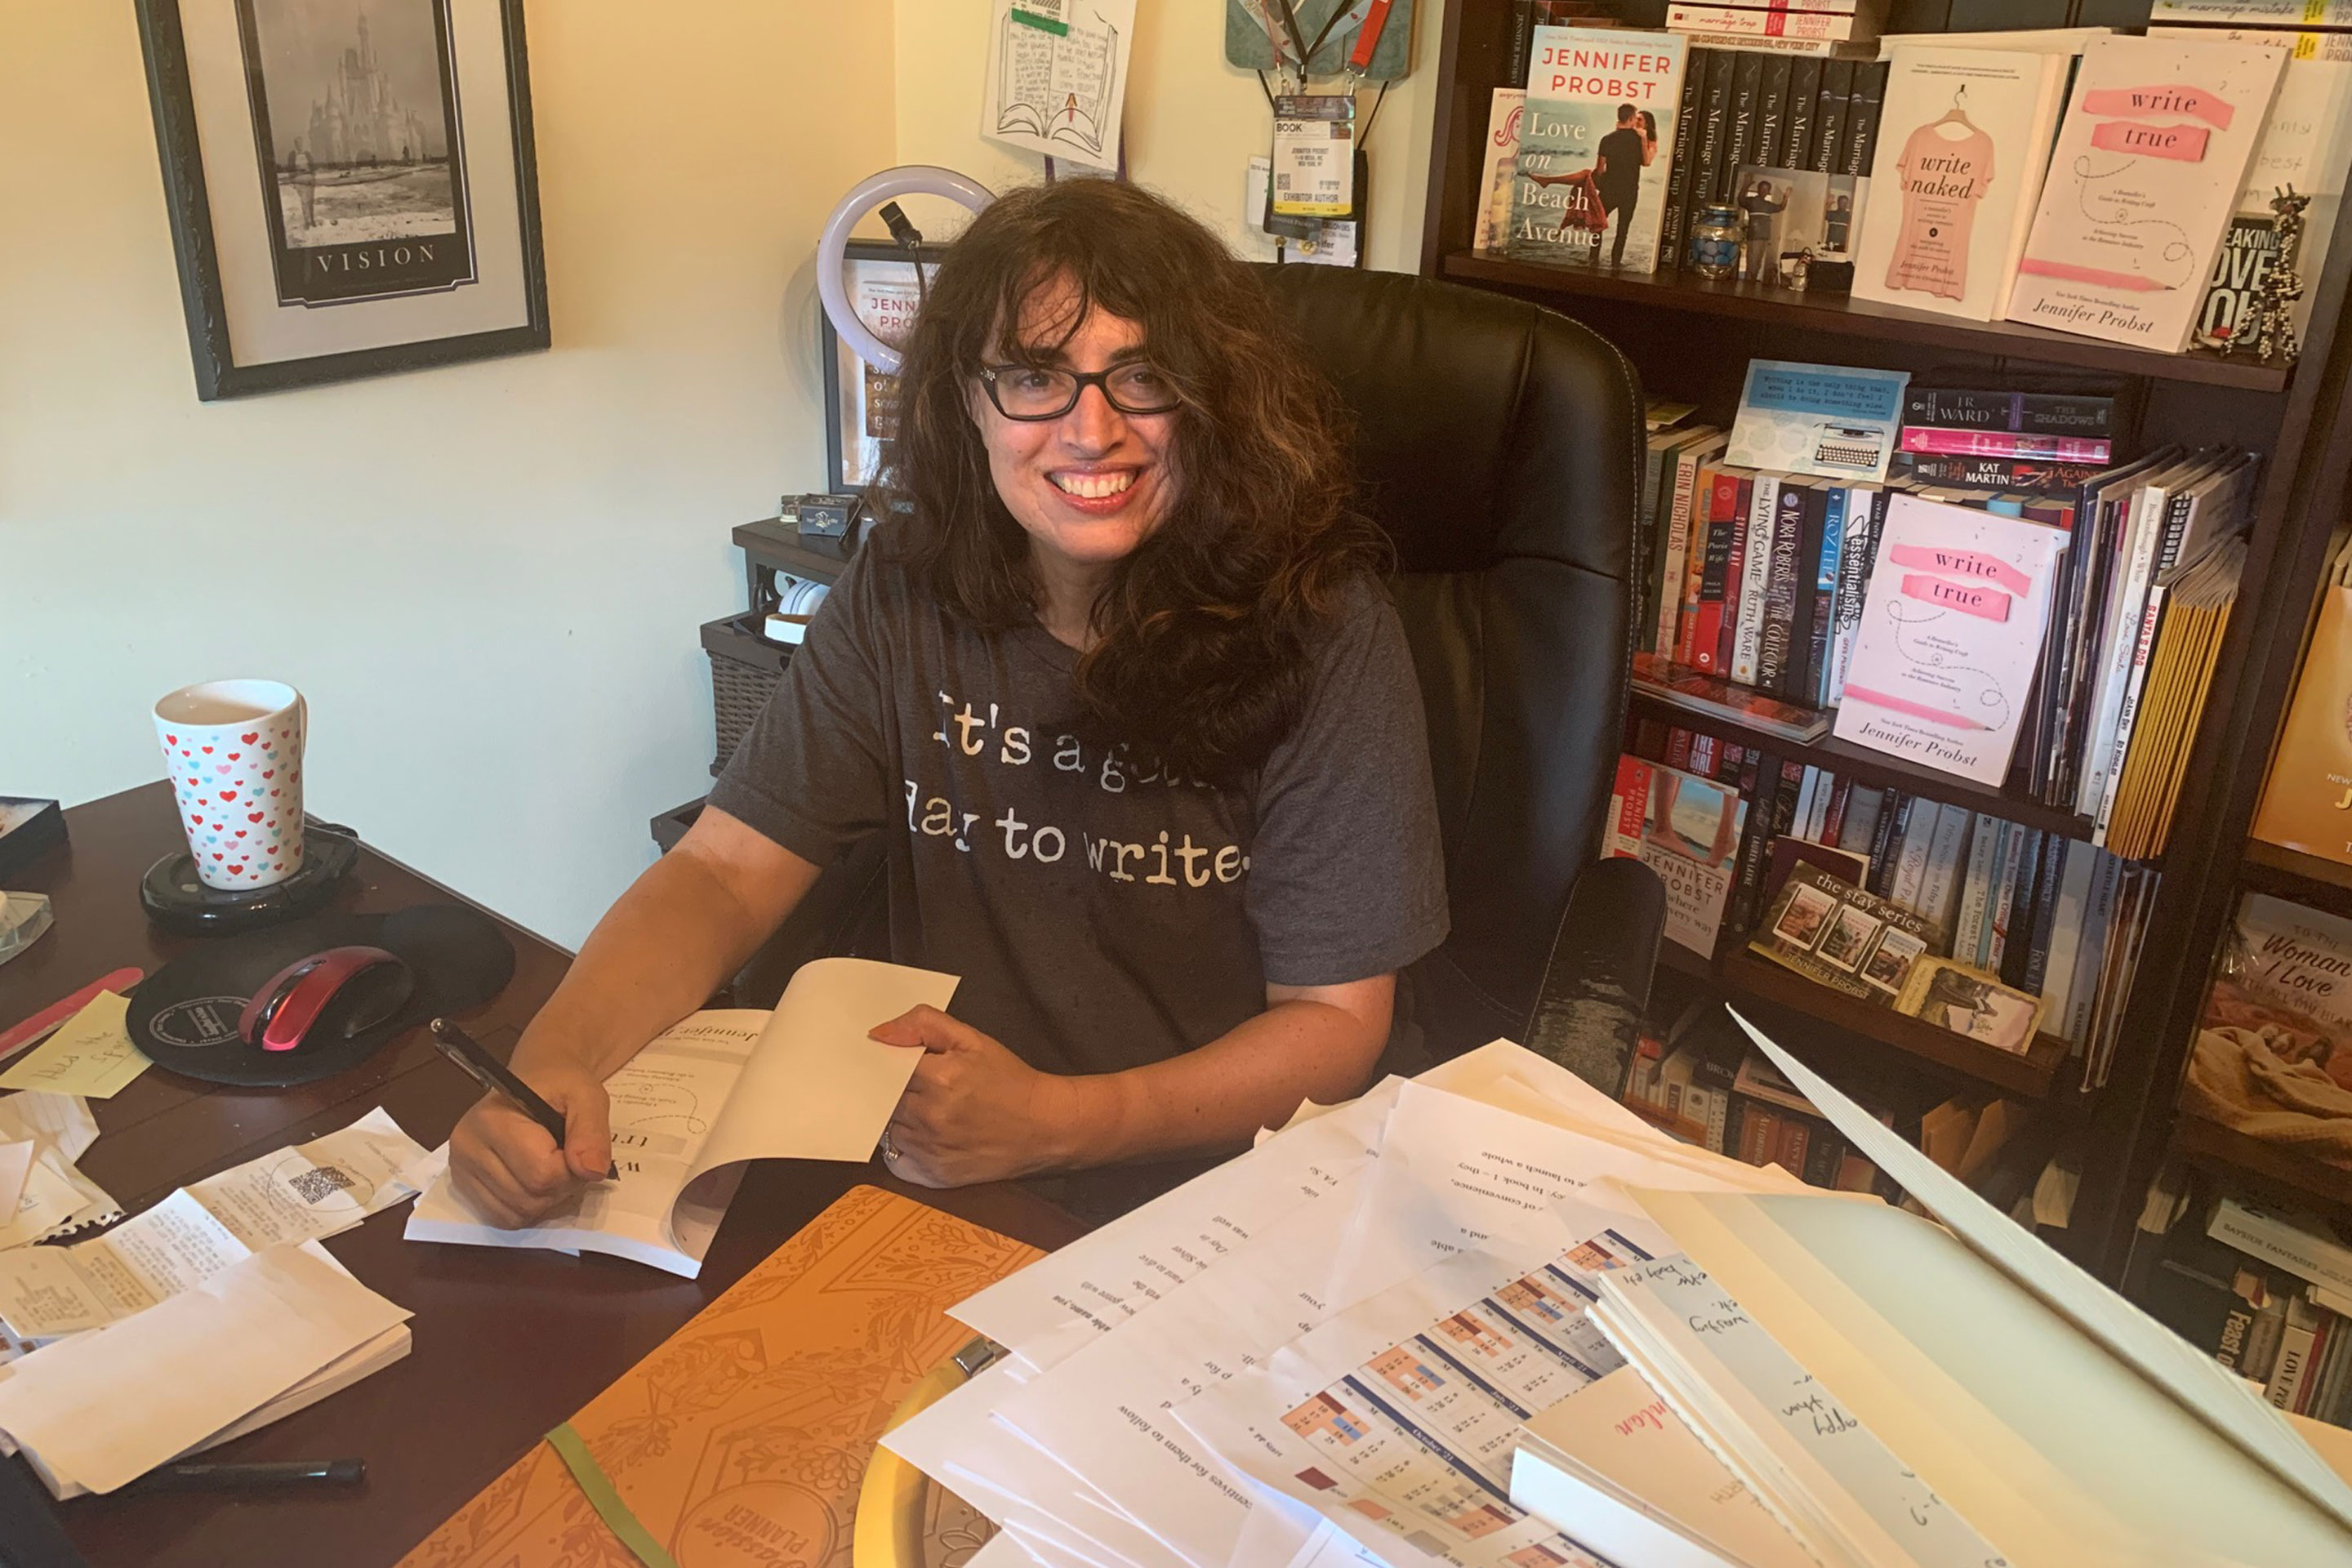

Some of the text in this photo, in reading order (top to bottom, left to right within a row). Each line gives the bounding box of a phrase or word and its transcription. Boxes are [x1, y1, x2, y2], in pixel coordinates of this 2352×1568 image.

[1795, 16, 1832, 29] JENNIFER
[1797, 27, 1827, 39] PROBST
[1542, 47, 1671, 74] JENNIFER
[1552, 75, 1656, 100] PROBST
[1685, 85, 1693, 103] The
[1740, 90, 1749, 108] The
[1766, 92, 1777, 110] The
[1797, 95, 1807, 113] The
[2131, 90, 2198, 114] write
[1276, 122, 1303, 133] BOOK
[1529, 113, 1586, 140] Love
[1826, 114, 1835, 128] The
[1857, 118, 1866, 132] The
[1675, 106, 1695, 163] Marriage
[1696, 87, 1722, 199] The Marriage Trap
[2124, 127, 2178, 149] true
[1525, 153, 1552, 170] on
[1920, 153, 1971, 176] write
[1671, 164, 1686, 197] Trap
[1910, 176, 1976, 200] naked
[1283, 192, 1339, 203] EXHIBITOR AUTHOR
[1521, 182, 1589, 212] Beach
[1517, 217, 1601, 247] Avenue
[317, 244, 434, 273] VISION
[2033, 298, 2154, 334] Jennifer Probst
[1824, 381, 1841, 390] only
[1940, 408, 1991, 423] WARD
[2034, 414, 2096, 425] SHADOWS
[1965, 471, 2010, 486] MARTIN
[1979, 462, 2001, 474] KAT
[1668, 461, 1694, 552] ERIN NICHOLAS
[1755, 497, 1771, 540] LYING
[1712, 528, 1728, 537] The
[1779, 510, 1801, 541] NORA
[1825, 514, 1841, 552] ROZ
[1873, 500, 1884, 541] ANN RYAN
[1708, 542, 1729, 550] Paris
[1730, 515, 1746, 568] SYLVIA DAY
[1708, 554, 1726, 564] Wife
[1750, 540, 1766, 581] GAME
[1773, 541, 1797, 583] ROBERTS
[1936, 553, 1998, 579] write
[1842, 537, 1868, 618] essentialism
[1933, 582, 1983, 608] true
[1744, 589, 1757, 628] RUTH
[2137, 604, 2158, 648] SANTA'S
[1740, 627, 1755, 660] WARE
[1761, 619, 1783, 679] COLLECTOR
[1052, 734, 1086, 773] a
[1695, 733, 1716, 755] THE
[1859, 722, 1979, 768] Jennifer Probst
[1689, 751, 1713, 774] GIRL
[1621, 788, 1637, 831] PROBST
[1632, 786, 1647, 838] JENNIFER
[995, 807, 1067, 864] to
[1751, 835, 1762, 859] LAUREN
[1642, 852, 1725, 896] JENNIFER
[1816, 873, 1841, 894] the
[1844, 889, 1877, 915] stay
[1878, 905, 1923, 934] series
[1972, 907, 1983, 940] Forest
[2262, 933, 2352, 978] Woman
[1786, 952, 1870, 1000] JENNIFER PROBST
[2265, 960, 2333, 998] I Love
[677, 1026, 759, 1042] Jennifer
[1481, 1151, 1514, 1165] whole
[1457, 1162, 1544, 1195] In book they
[1525, 1164, 1561, 1183] launch
[1563, 1177, 1575, 1187] to
[1450, 1178, 1536, 1213] of convenience,
[1211, 1214, 1250, 1241] was well
[1170, 1244, 1198, 1264] Silver
[1199, 1233, 1228, 1255] Day in
[1429, 1239, 1455, 1254] able
[2223, 1223, 2319, 1272] BAYSIDE FANTASIES
[1138, 1254, 1159, 1272] dive
[1051, 1294, 1072, 1312] you
[1080, 1281, 1125, 1307] genre with
[1298, 1290, 1326, 1312] your
[1069, 1300, 1094, 1321] name,
[2221, 1308, 2252, 1356] Feast
[1203, 1359, 1222, 1377] for
[1557, 1350, 1576, 1365] April
[2278, 1348, 2301, 1386] LOVE
[1490, 1390, 1508, 1405] July
[1116, 1404, 1152, 1434] follow
[1152, 1430, 1165, 1446] to
[1163, 1438, 1192, 1463] them
[1411, 1428, 1442, 1453] October
[1191, 1460, 1209, 1478] for
[724, 1503, 810, 1555] PLANNER
